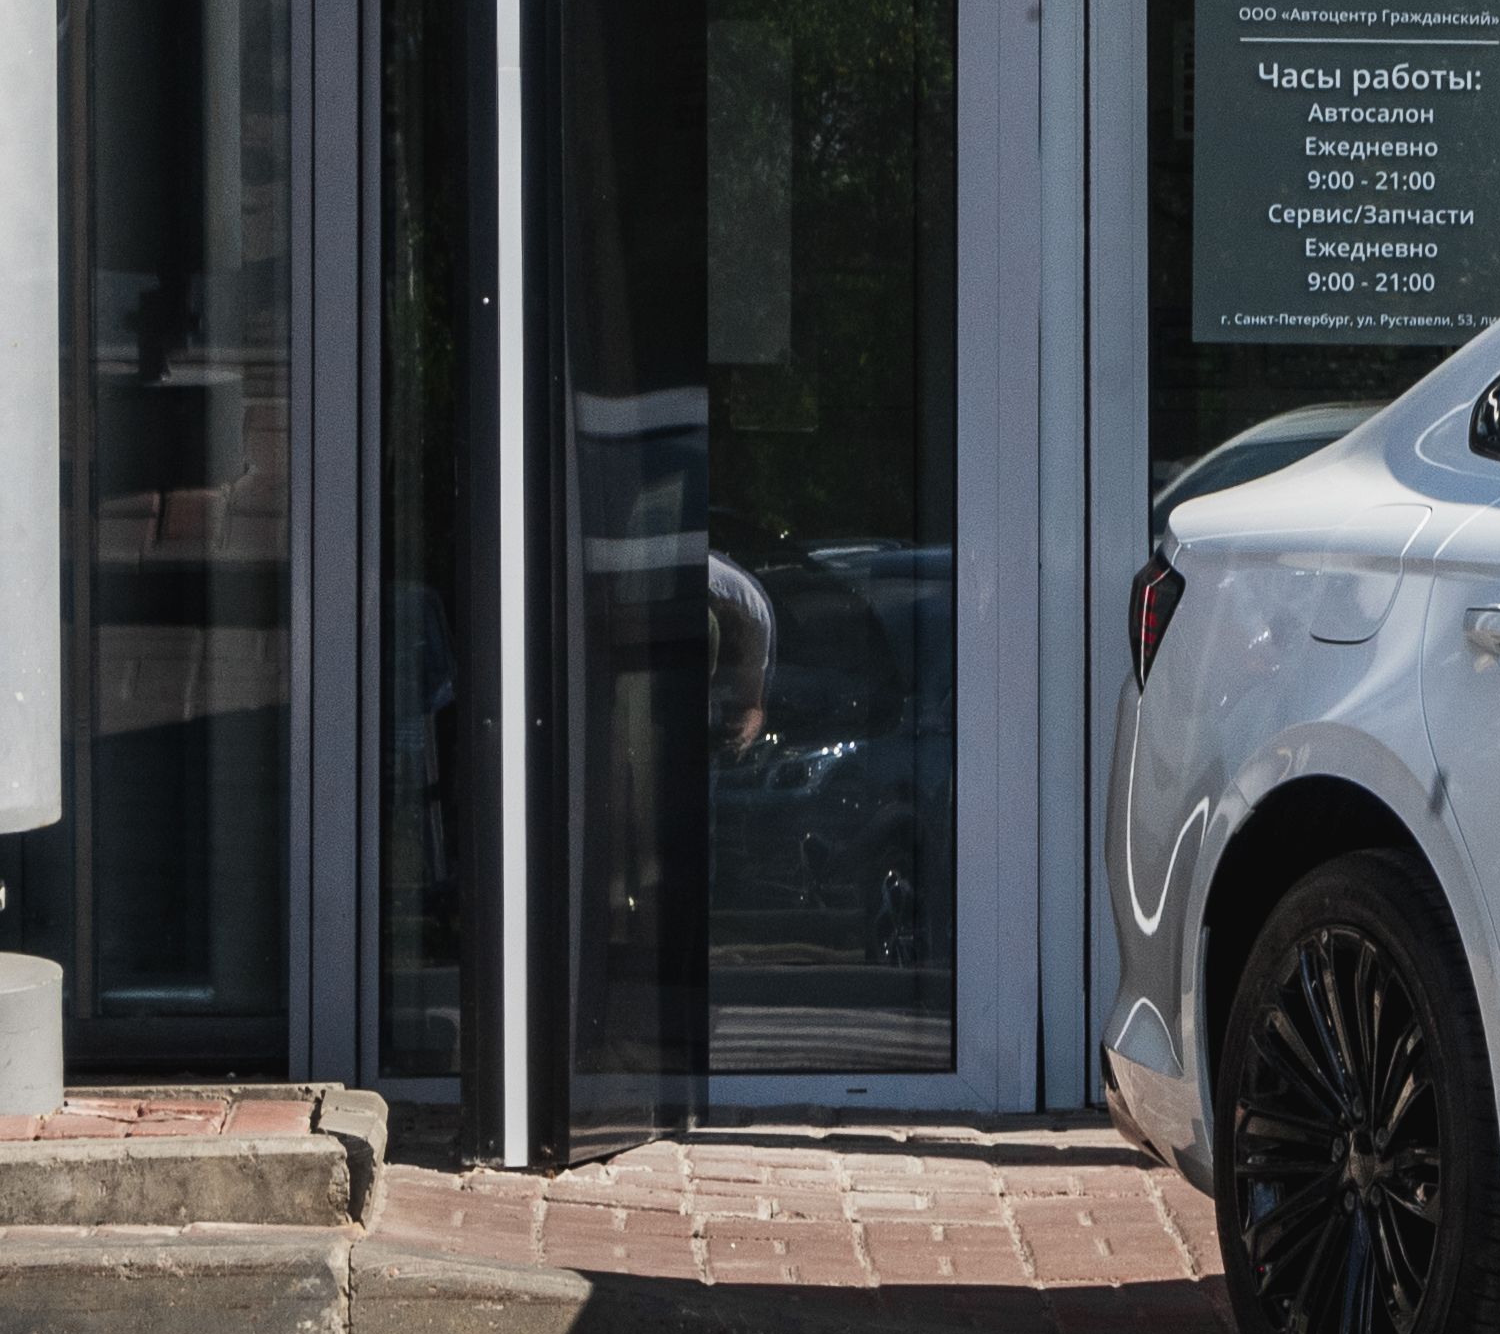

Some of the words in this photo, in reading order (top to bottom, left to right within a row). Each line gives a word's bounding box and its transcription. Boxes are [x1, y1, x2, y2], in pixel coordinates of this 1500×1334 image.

[1238, 6, 1277, 21] ООО
[1281, 7, 1378, 27] «Автоцентр
[1382, 9, 1500, 27] Гражданский»
[1258, 62, 1341, 89] Часы
[1353, 62, 1482, 97] работы:
[1307, 102, 1434, 124] Автосалон
[1305, 136, 1439, 161] Ежедневно
[1307, 170, 1355, 190] 9:00
[1375, 170, 1436, 191] 21:00
[1268, 203, 1474, 229] Сервис/Запчасти
[1305, 237, 1438, 262] Ежедневно
[1307, 271, 1355, 292] 9:00
[1375, 272, 1435, 292] 21:00
[1220, 315, 1231, 325] г.
[1234, 312, 1354, 329] Санкт-Петербург,
[1356, 315, 1377, 329] ул.
[1380, 313, 1454, 329] Руставели,
[1457, 313, 1477, 328] 53,
